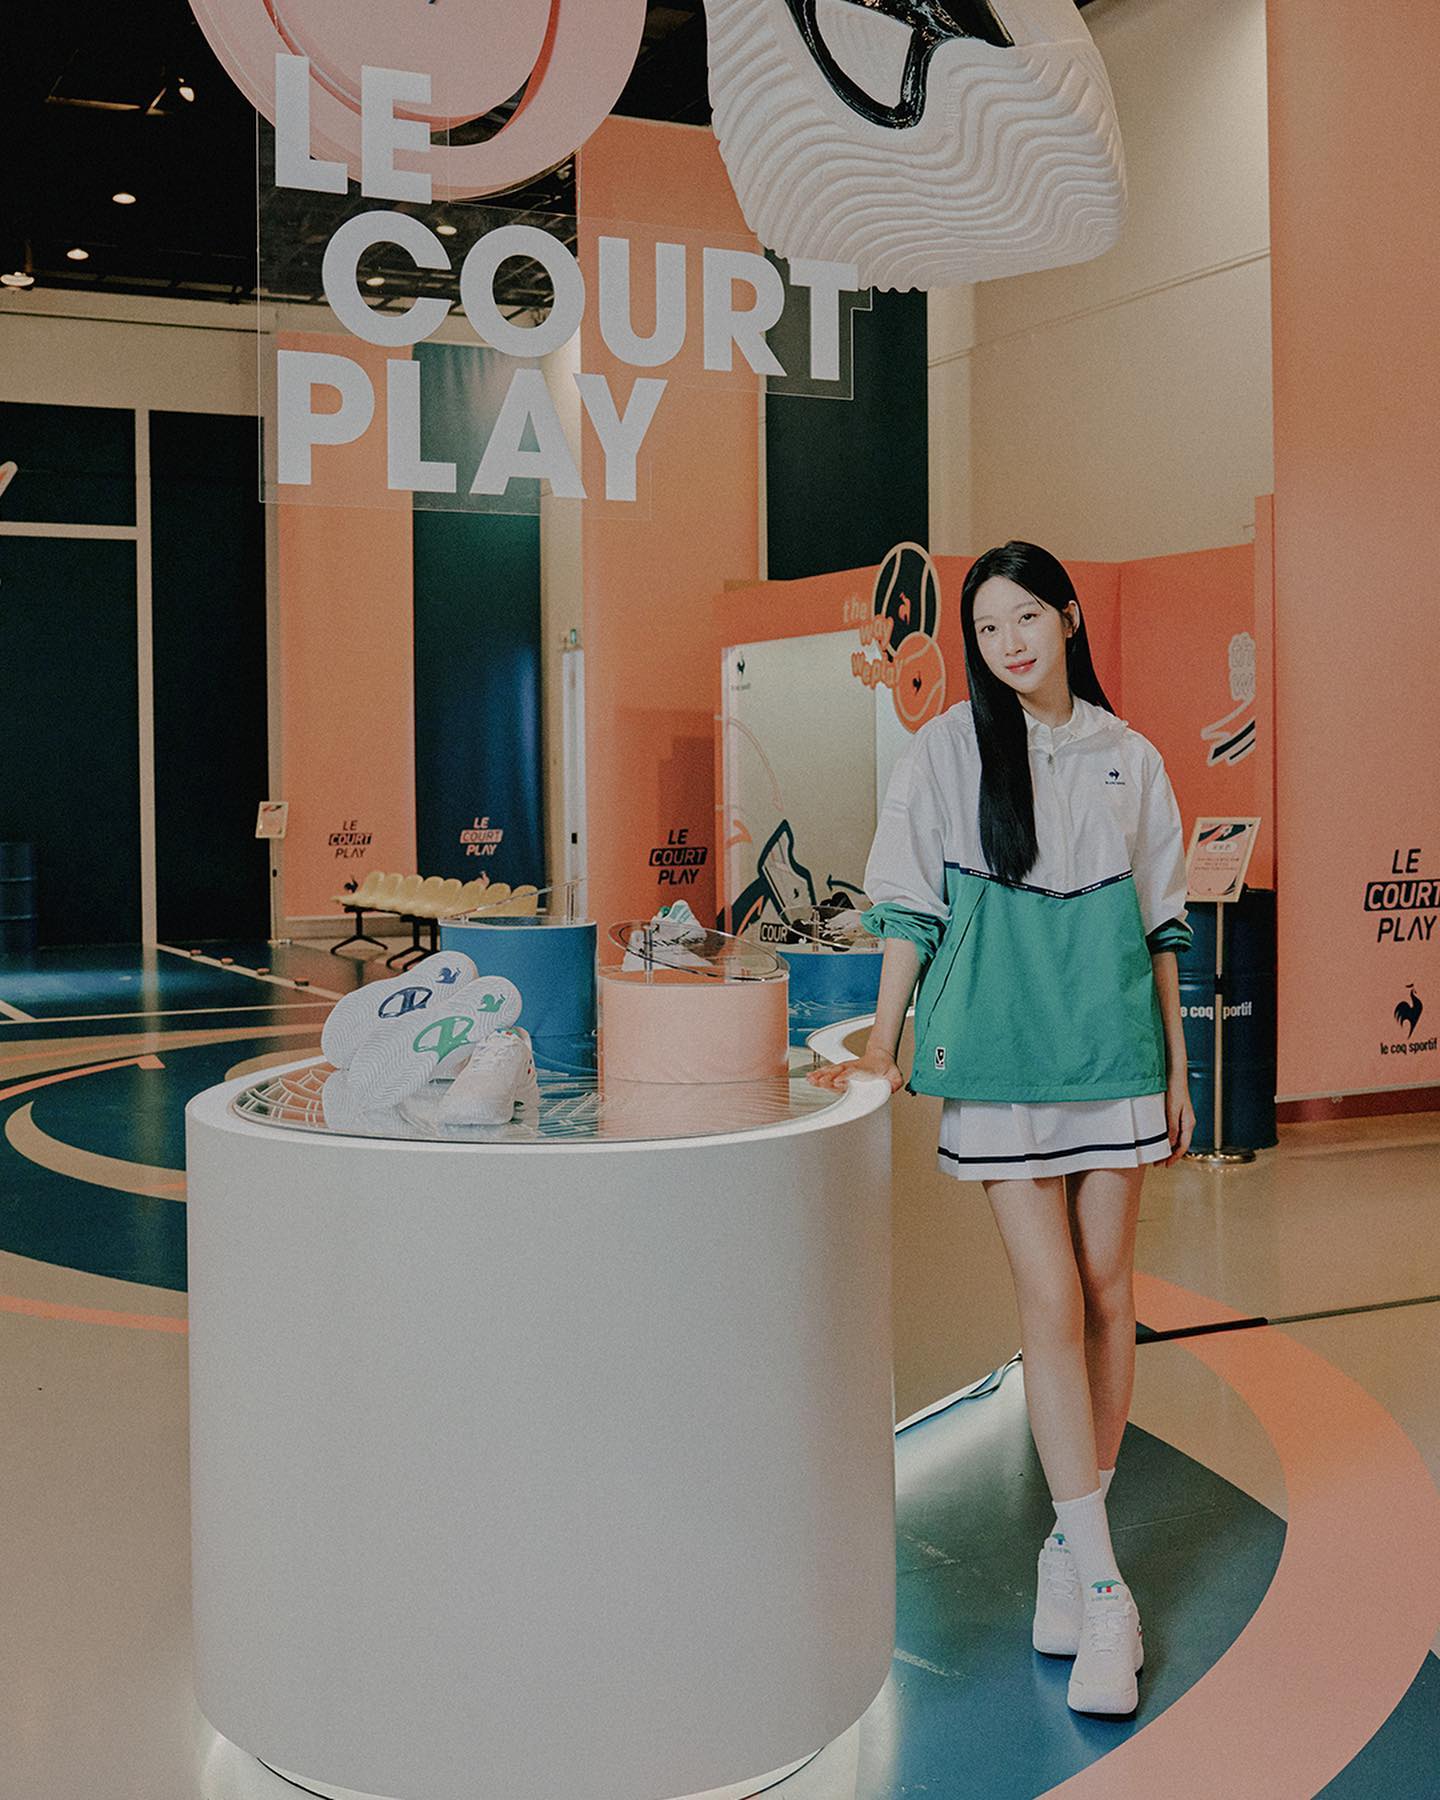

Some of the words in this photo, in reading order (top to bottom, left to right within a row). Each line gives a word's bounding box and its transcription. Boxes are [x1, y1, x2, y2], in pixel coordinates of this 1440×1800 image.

[275, 53, 432, 205] LE
[322, 210, 859, 381] COURT
[277, 349, 668, 502] PLAY
[843, 596, 868, 623] the
[343, 820, 357, 831] LE
[474, 817, 489, 829] LE
[329, 833, 372, 846] COURT
[461, 830, 503, 843] COURT
[668, 829, 688, 845] LE
[335, 848, 366, 858] PLAY
[466, 845, 496, 856] PLAY
[651, 848, 705, 865] COURT
[1391, 848, 1422, 874] LE
[657, 869, 699, 885] PLAY
[761, 923, 789, 943] COUR
[1377, 915, 1437, 943] PLAY
[1189, 1005, 1214, 1020] coq
[1222, 1001, 1252, 1020] portif
[1380, 1042, 1389, 1055] le
[1390, 1043, 1407, 1055] coq
[1408, 1037, 1438, 1054] sportif
